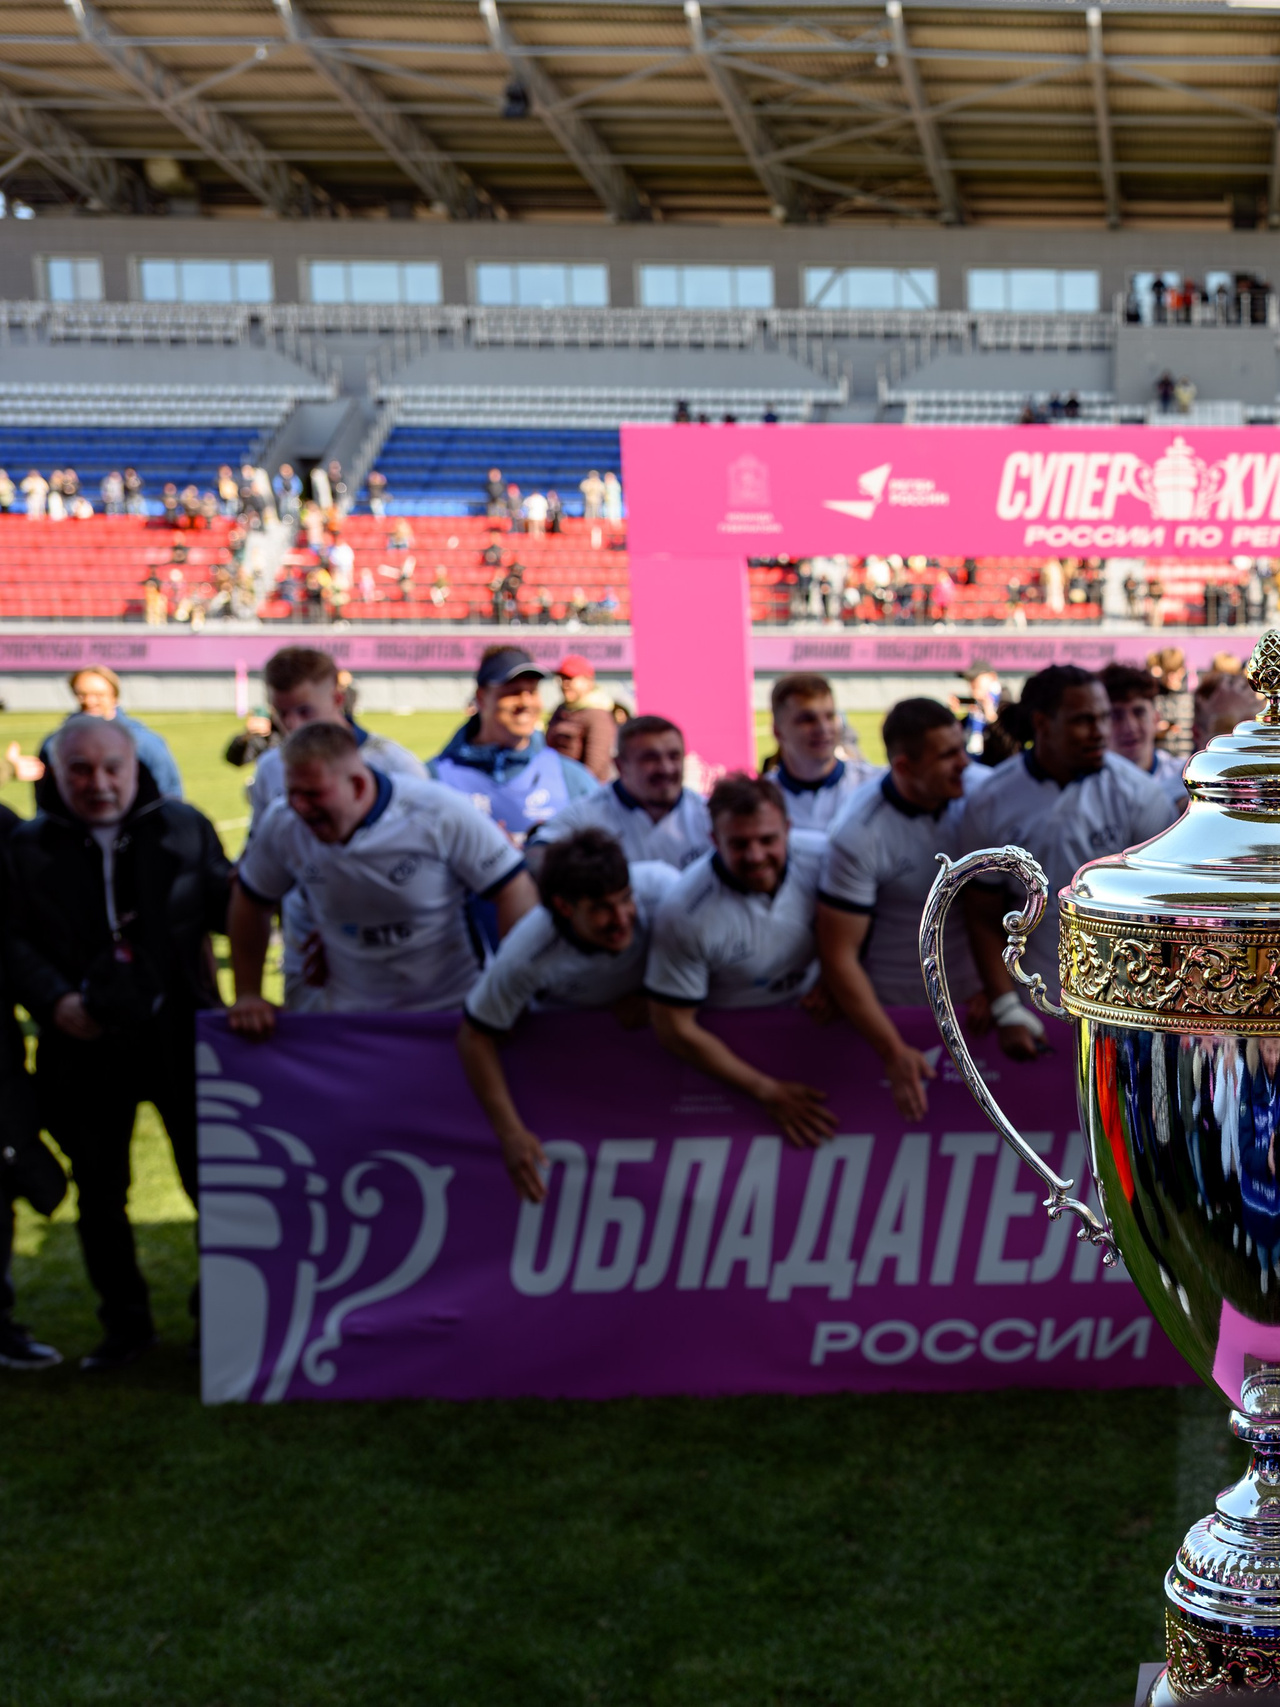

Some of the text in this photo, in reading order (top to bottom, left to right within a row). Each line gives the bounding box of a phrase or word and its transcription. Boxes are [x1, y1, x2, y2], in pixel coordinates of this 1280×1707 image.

[997, 452, 1140, 520] СУПЕР
[1023, 525, 1167, 548] РОССИИ
[1174, 525, 1223, 548] ПО
[510, 1132, 1133, 1301] ОБЛАДАТЕЛ
[810, 1317, 1153, 1366] РОССИИ
